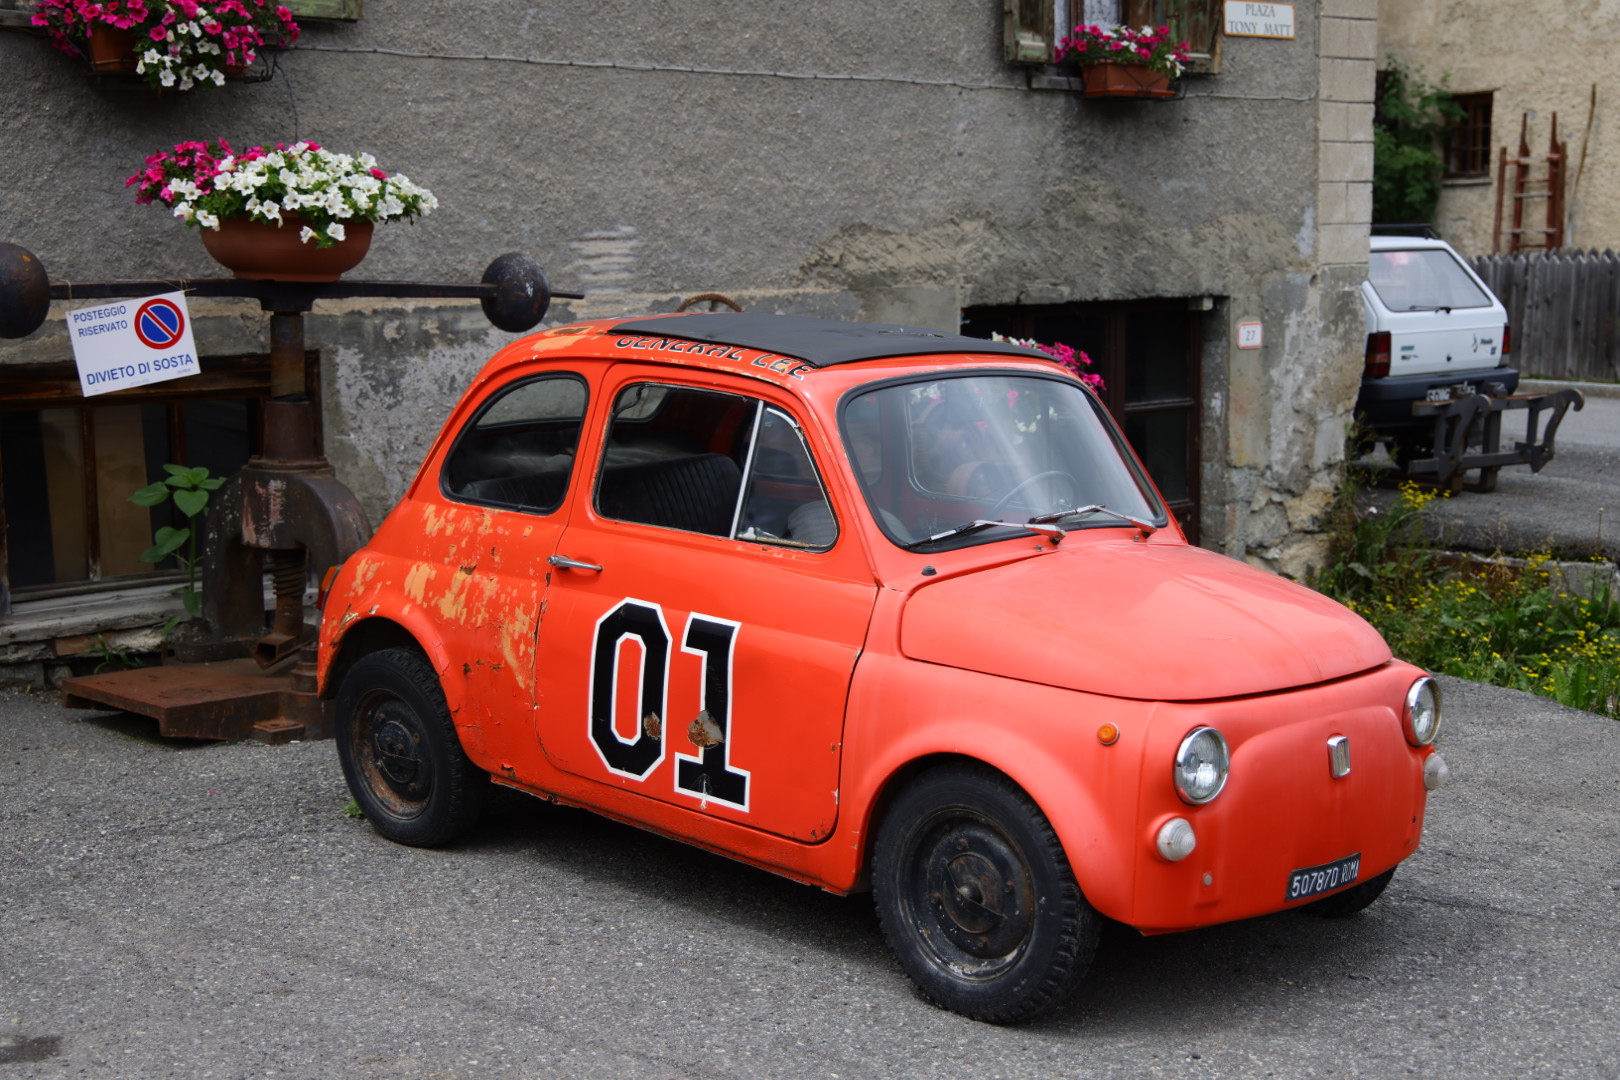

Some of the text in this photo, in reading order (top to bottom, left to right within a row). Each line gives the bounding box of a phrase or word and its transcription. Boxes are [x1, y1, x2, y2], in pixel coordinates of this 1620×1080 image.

[1245, 3, 1276, 17] PLAZA
[1228, 20, 1292, 36] TONY MATT
[73, 305, 127, 323] POSTEGGIO
[78, 319, 128, 338] RISERVATO
[1245, 330, 1256, 342] 27
[615, 335, 815, 381] GENERAL LEE
[86, 365, 135, 386] DIVIETO
[138, 362, 151, 375] DI
[153, 353, 194, 372] SOSTA
[587, 596, 751, 813] 01
[1340, 859, 1360, 884] ROMA
